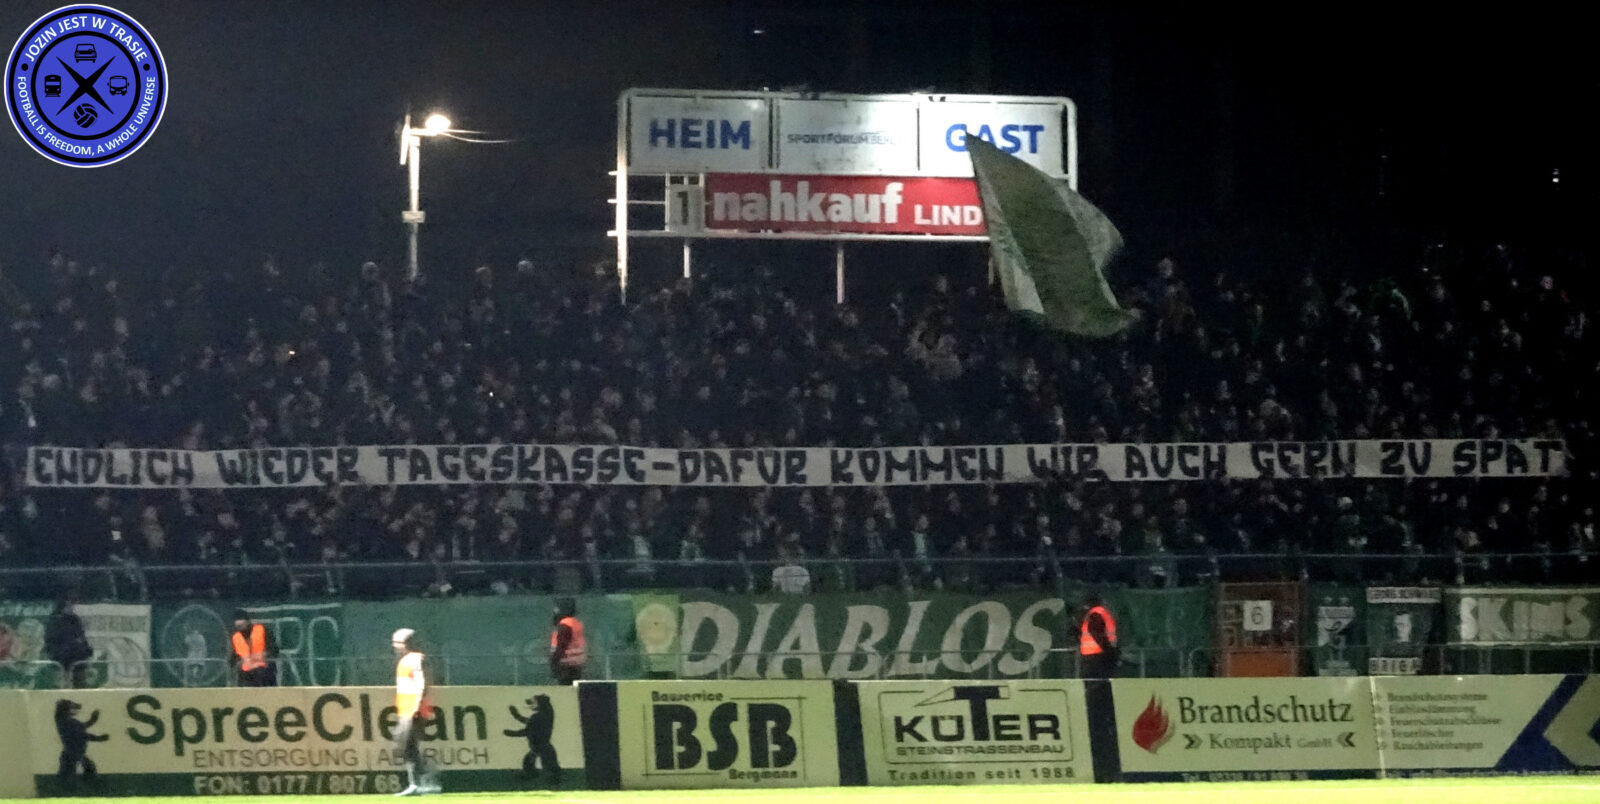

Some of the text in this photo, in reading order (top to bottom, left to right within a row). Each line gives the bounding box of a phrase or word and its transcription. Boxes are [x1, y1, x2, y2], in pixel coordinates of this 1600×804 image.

[649, 118, 751, 150] HEIM
[945, 123, 1044, 154] GAST
[712, 180, 983, 226] nahkauf LIND
[34, 449, 194, 485] ENDLICH
[217, 448, 358, 484] WIEDER
[831, 446, 1004, 482] KOMMEN
[1027, 446, 1100, 479] WIR
[1124, 444, 1227, 479] AUCH
[1251, 442, 1356, 477] GERN
[1380, 442, 1432, 475] ZU
[1251, 607, 1264, 625] 6
[677, 599, 1064, 681] DIABLOS
[126, 693, 488, 756] SpreeClean
[894, 686, 1061, 742] KÜTER
[1178, 695, 1354, 724] Brandschutz
[653, 702, 797, 770] BSB
[896, 745, 1065, 756] STEINSTRASSENBAU
[1210, 732, 1292, 753] Kompakt
[194, 748, 359, 767] ENTSORGUNG
[377, 748, 489, 766] ABRUCH
[194, 776, 249, 793] FON:
[257, 776, 295, 793] 0177
[888, 767, 1075, 781] Tradition seit 1988
